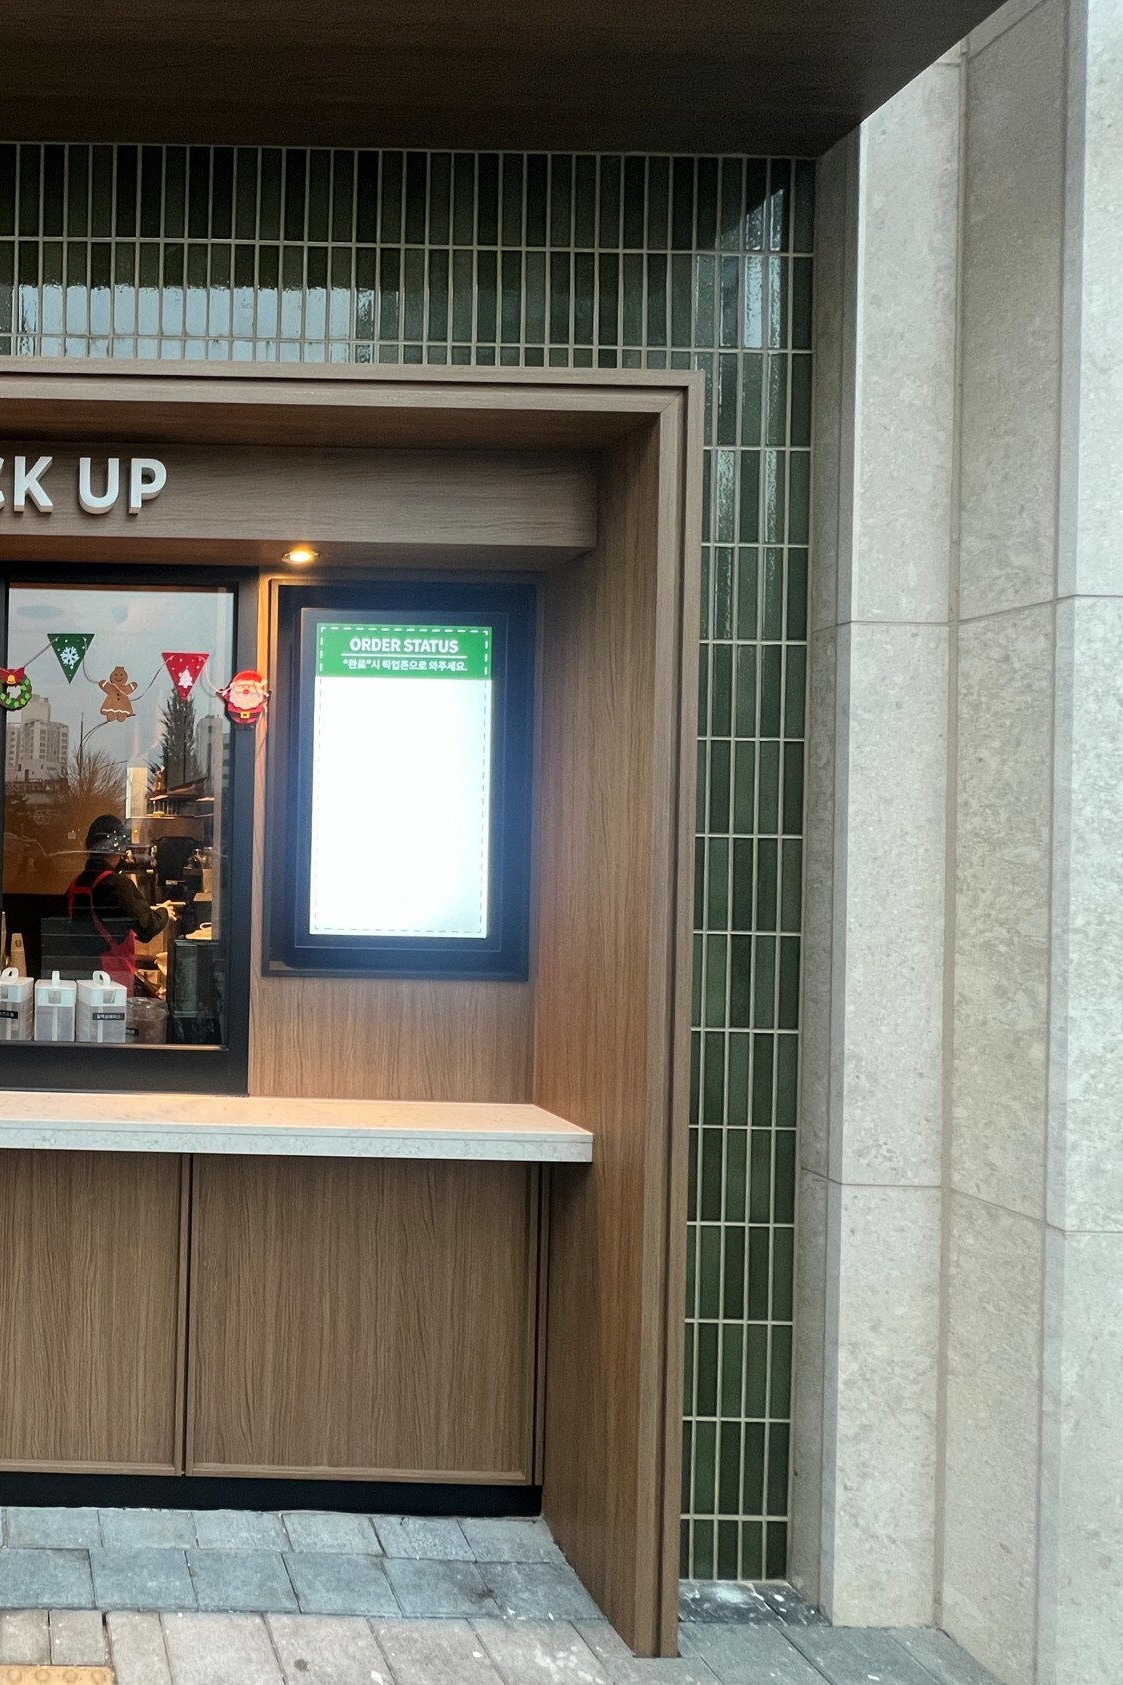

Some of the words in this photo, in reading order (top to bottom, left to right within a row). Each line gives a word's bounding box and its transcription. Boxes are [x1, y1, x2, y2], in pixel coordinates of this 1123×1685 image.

[79, 457, 167, 514] UP
[349, 638, 401, 652] ORDER
[403, 639, 459, 653] STATUS
